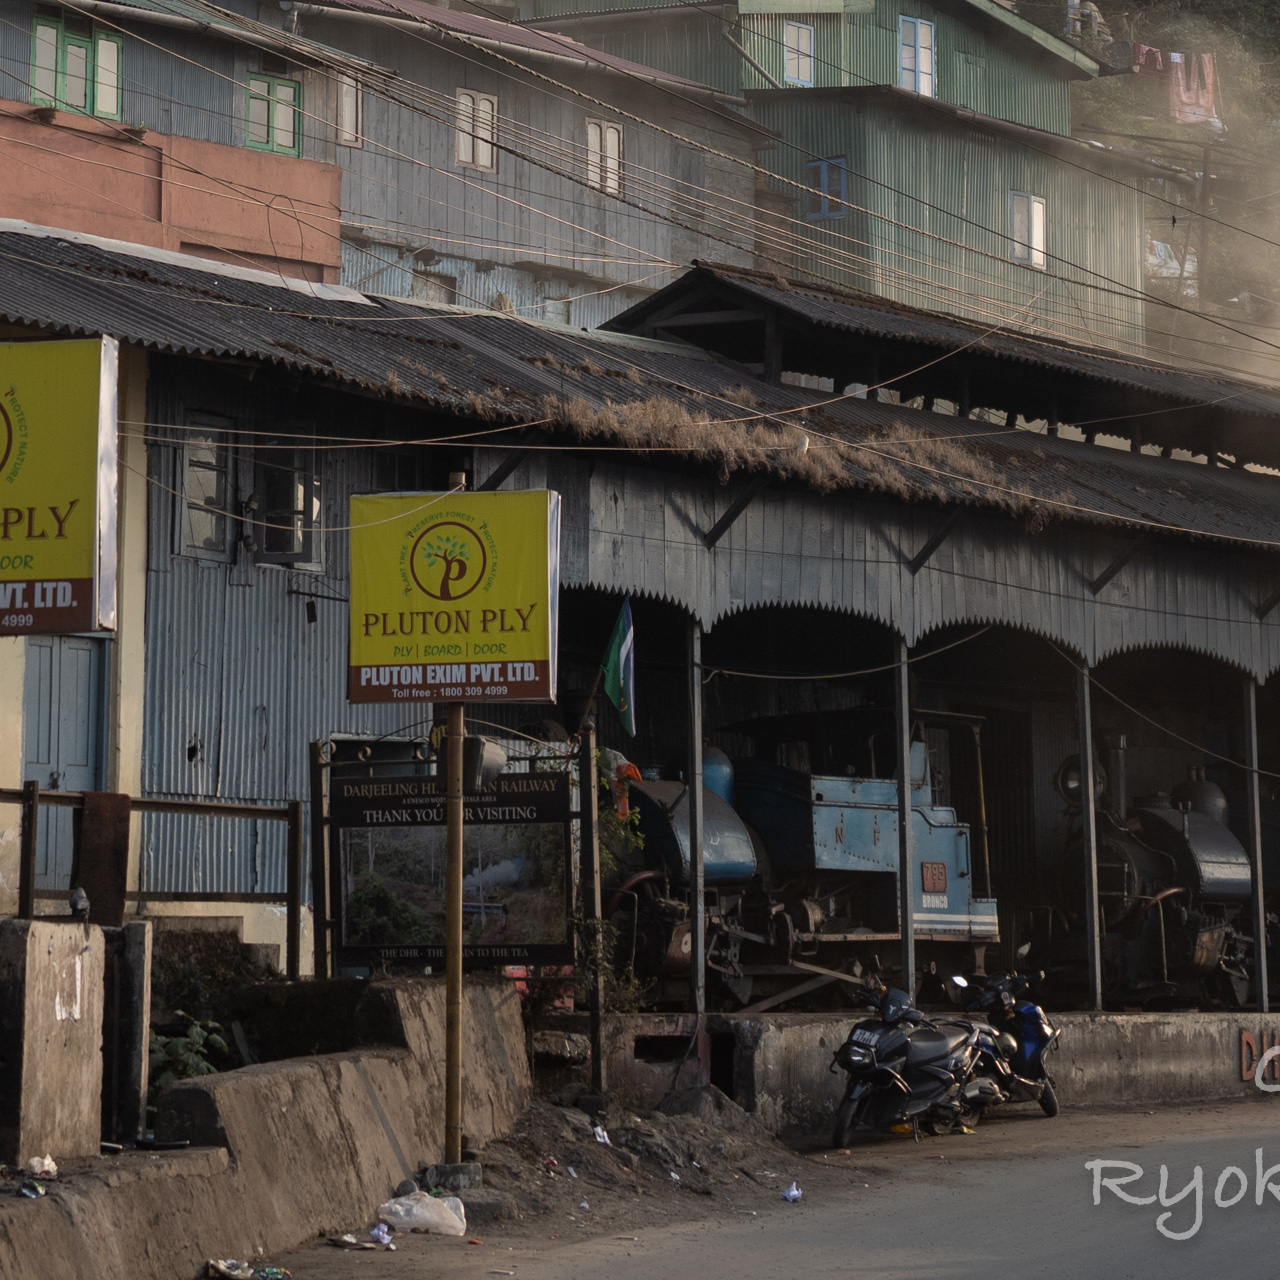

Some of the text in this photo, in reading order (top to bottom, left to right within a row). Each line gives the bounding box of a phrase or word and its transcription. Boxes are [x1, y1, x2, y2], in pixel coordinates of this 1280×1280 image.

[5, 388, 27, 483] PROTECT NATURE
[0, 498, 80, 540] PLY
[407, 511, 475, 538] PRESERVE FOREST
[480, 523, 498, 593] PROTECT NATURE
[400, 544, 412, 593] PLANT TREE
[34, 582, 77, 608] LTD.
[2, 615, 33, 627] 4999
[363, 603, 537, 638] PLUTON PLY
[394, 643, 506, 658] PLY BOARD DOOR
[361, 663, 539, 687] PLUTON EXIM PVT. LTD.
[392, 688, 410, 698] Toll
[412, 688, 432, 698] free
[440, 687, 463, 696] 1800
[465, 687, 483, 696] 309
[485, 686, 508, 696] 4999
[343, 783, 419, 798] DARJEELING
[501, 779, 558, 793] RAILWAY
[481, 795, 497, 803] AREA
[363, 810, 412, 823] THANK
[415, 808, 444, 821] YOU
[477, 807, 537, 820] VISITING
[835, 826, 881, 847] N F
[924, 864, 945, 880] 795
[922, 895, 948, 909] BRONCO
[380, 949, 398, 958] THE
[399, 949, 419, 958] DHR
[426, 948, 445, 957] THE
[476, 948, 490, 957] TO
[491, 948, 509, 957] THE
[510, 948, 529, 957] TEA
